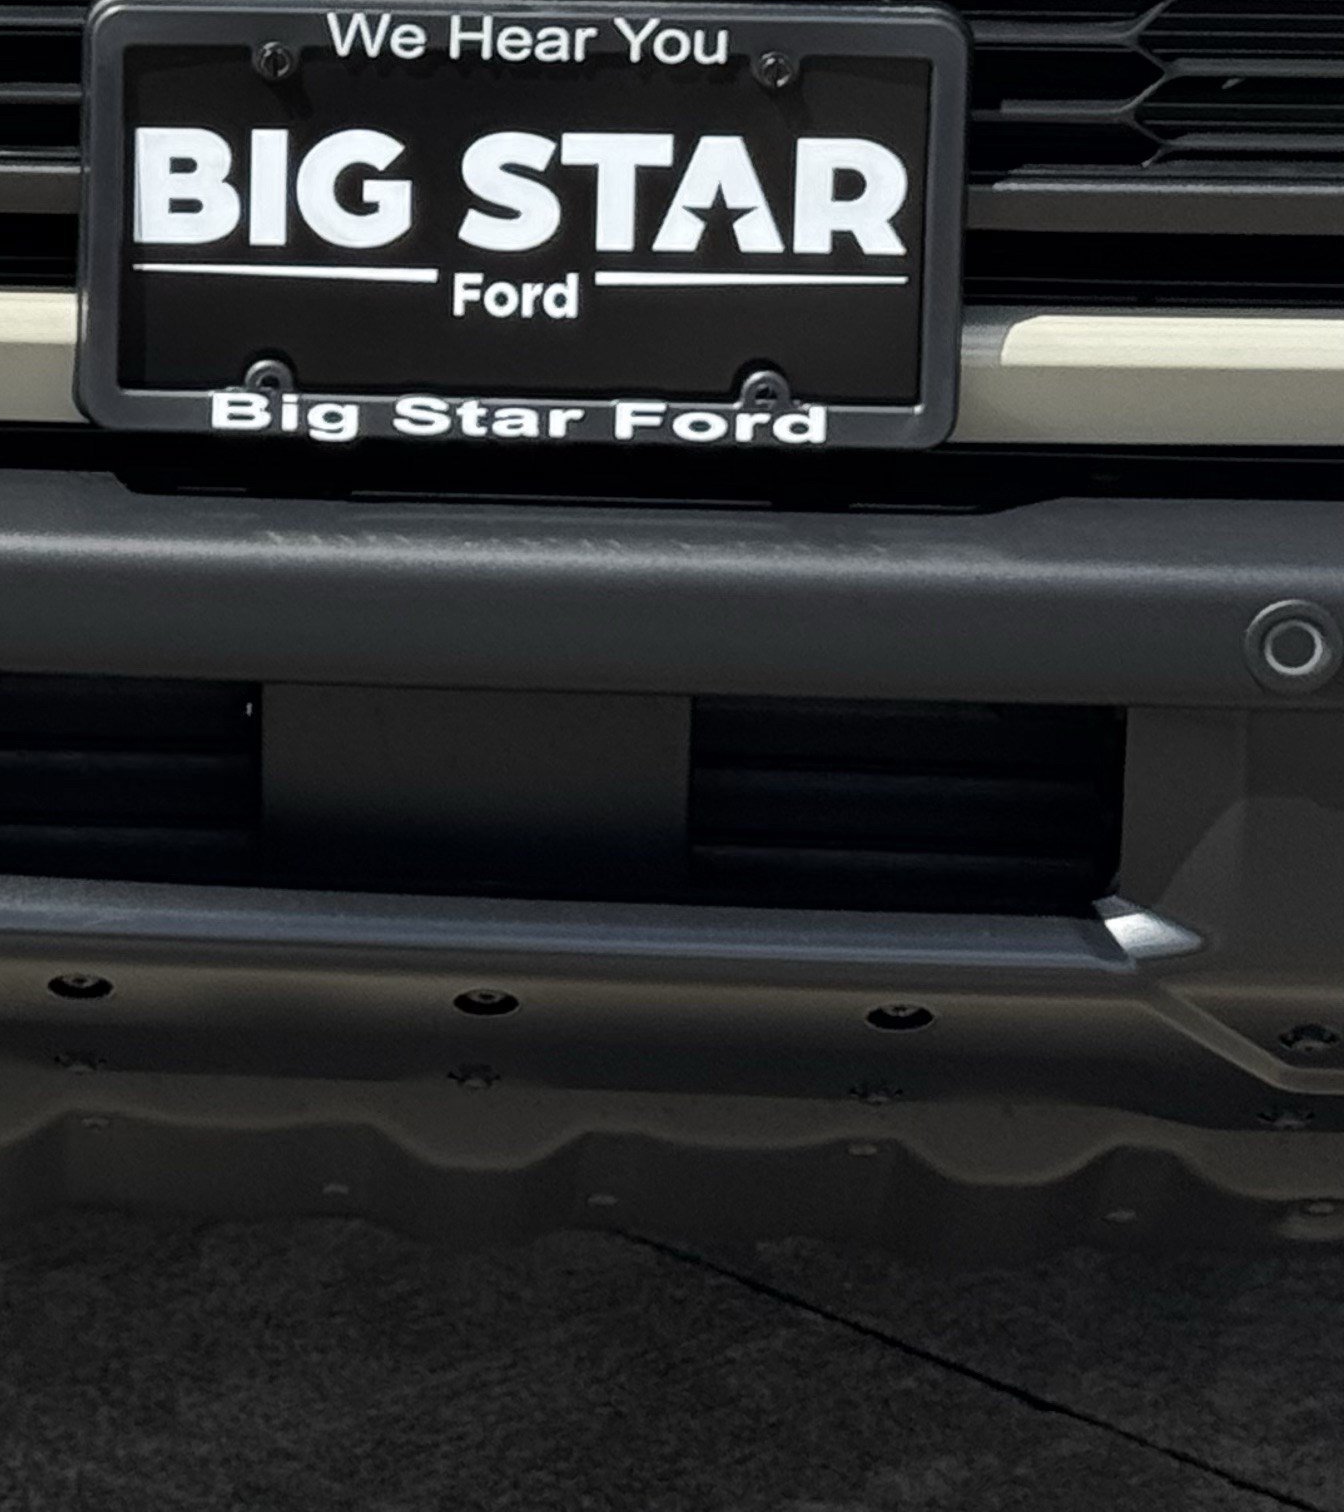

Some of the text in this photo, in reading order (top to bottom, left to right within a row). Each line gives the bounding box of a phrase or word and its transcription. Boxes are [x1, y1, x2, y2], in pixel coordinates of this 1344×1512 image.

[326, 12, 728, 65] We Hear You
[133, 127, 908, 256] BIG STAR
[453, 272, 579, 319] Ford
[211, 389, 828, 444] Big Star Ford
